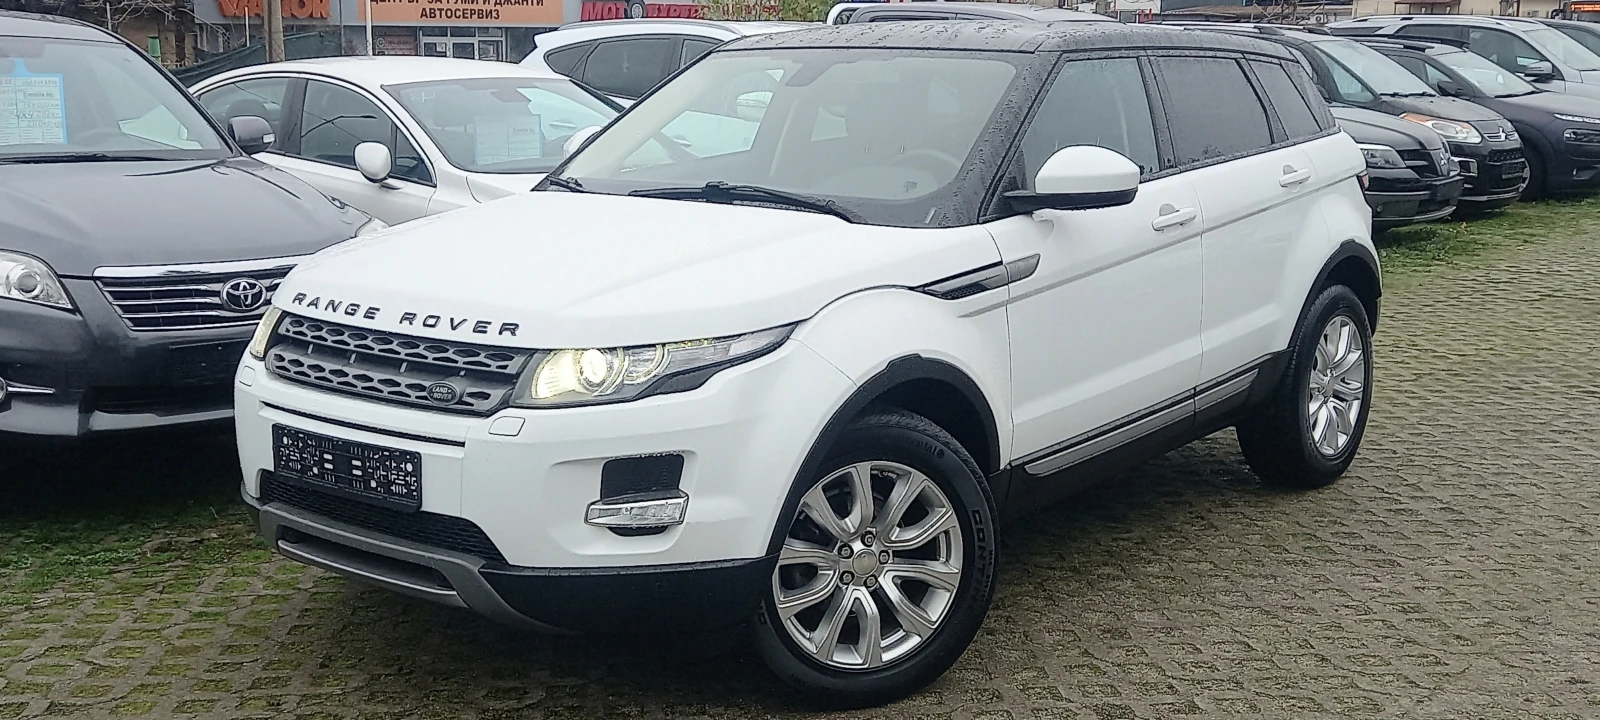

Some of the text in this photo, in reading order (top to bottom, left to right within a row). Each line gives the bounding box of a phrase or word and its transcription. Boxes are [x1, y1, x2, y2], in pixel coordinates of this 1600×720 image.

[218, 0, 330, 18] VIAOR
[420, 8, 500, 20] АВТОСЕРВИЗ
[291, 292, 520, 337] RANGE ROVER
[432, 386, 448, 394] LAND
[433, 392, 452, 400] ROVER
